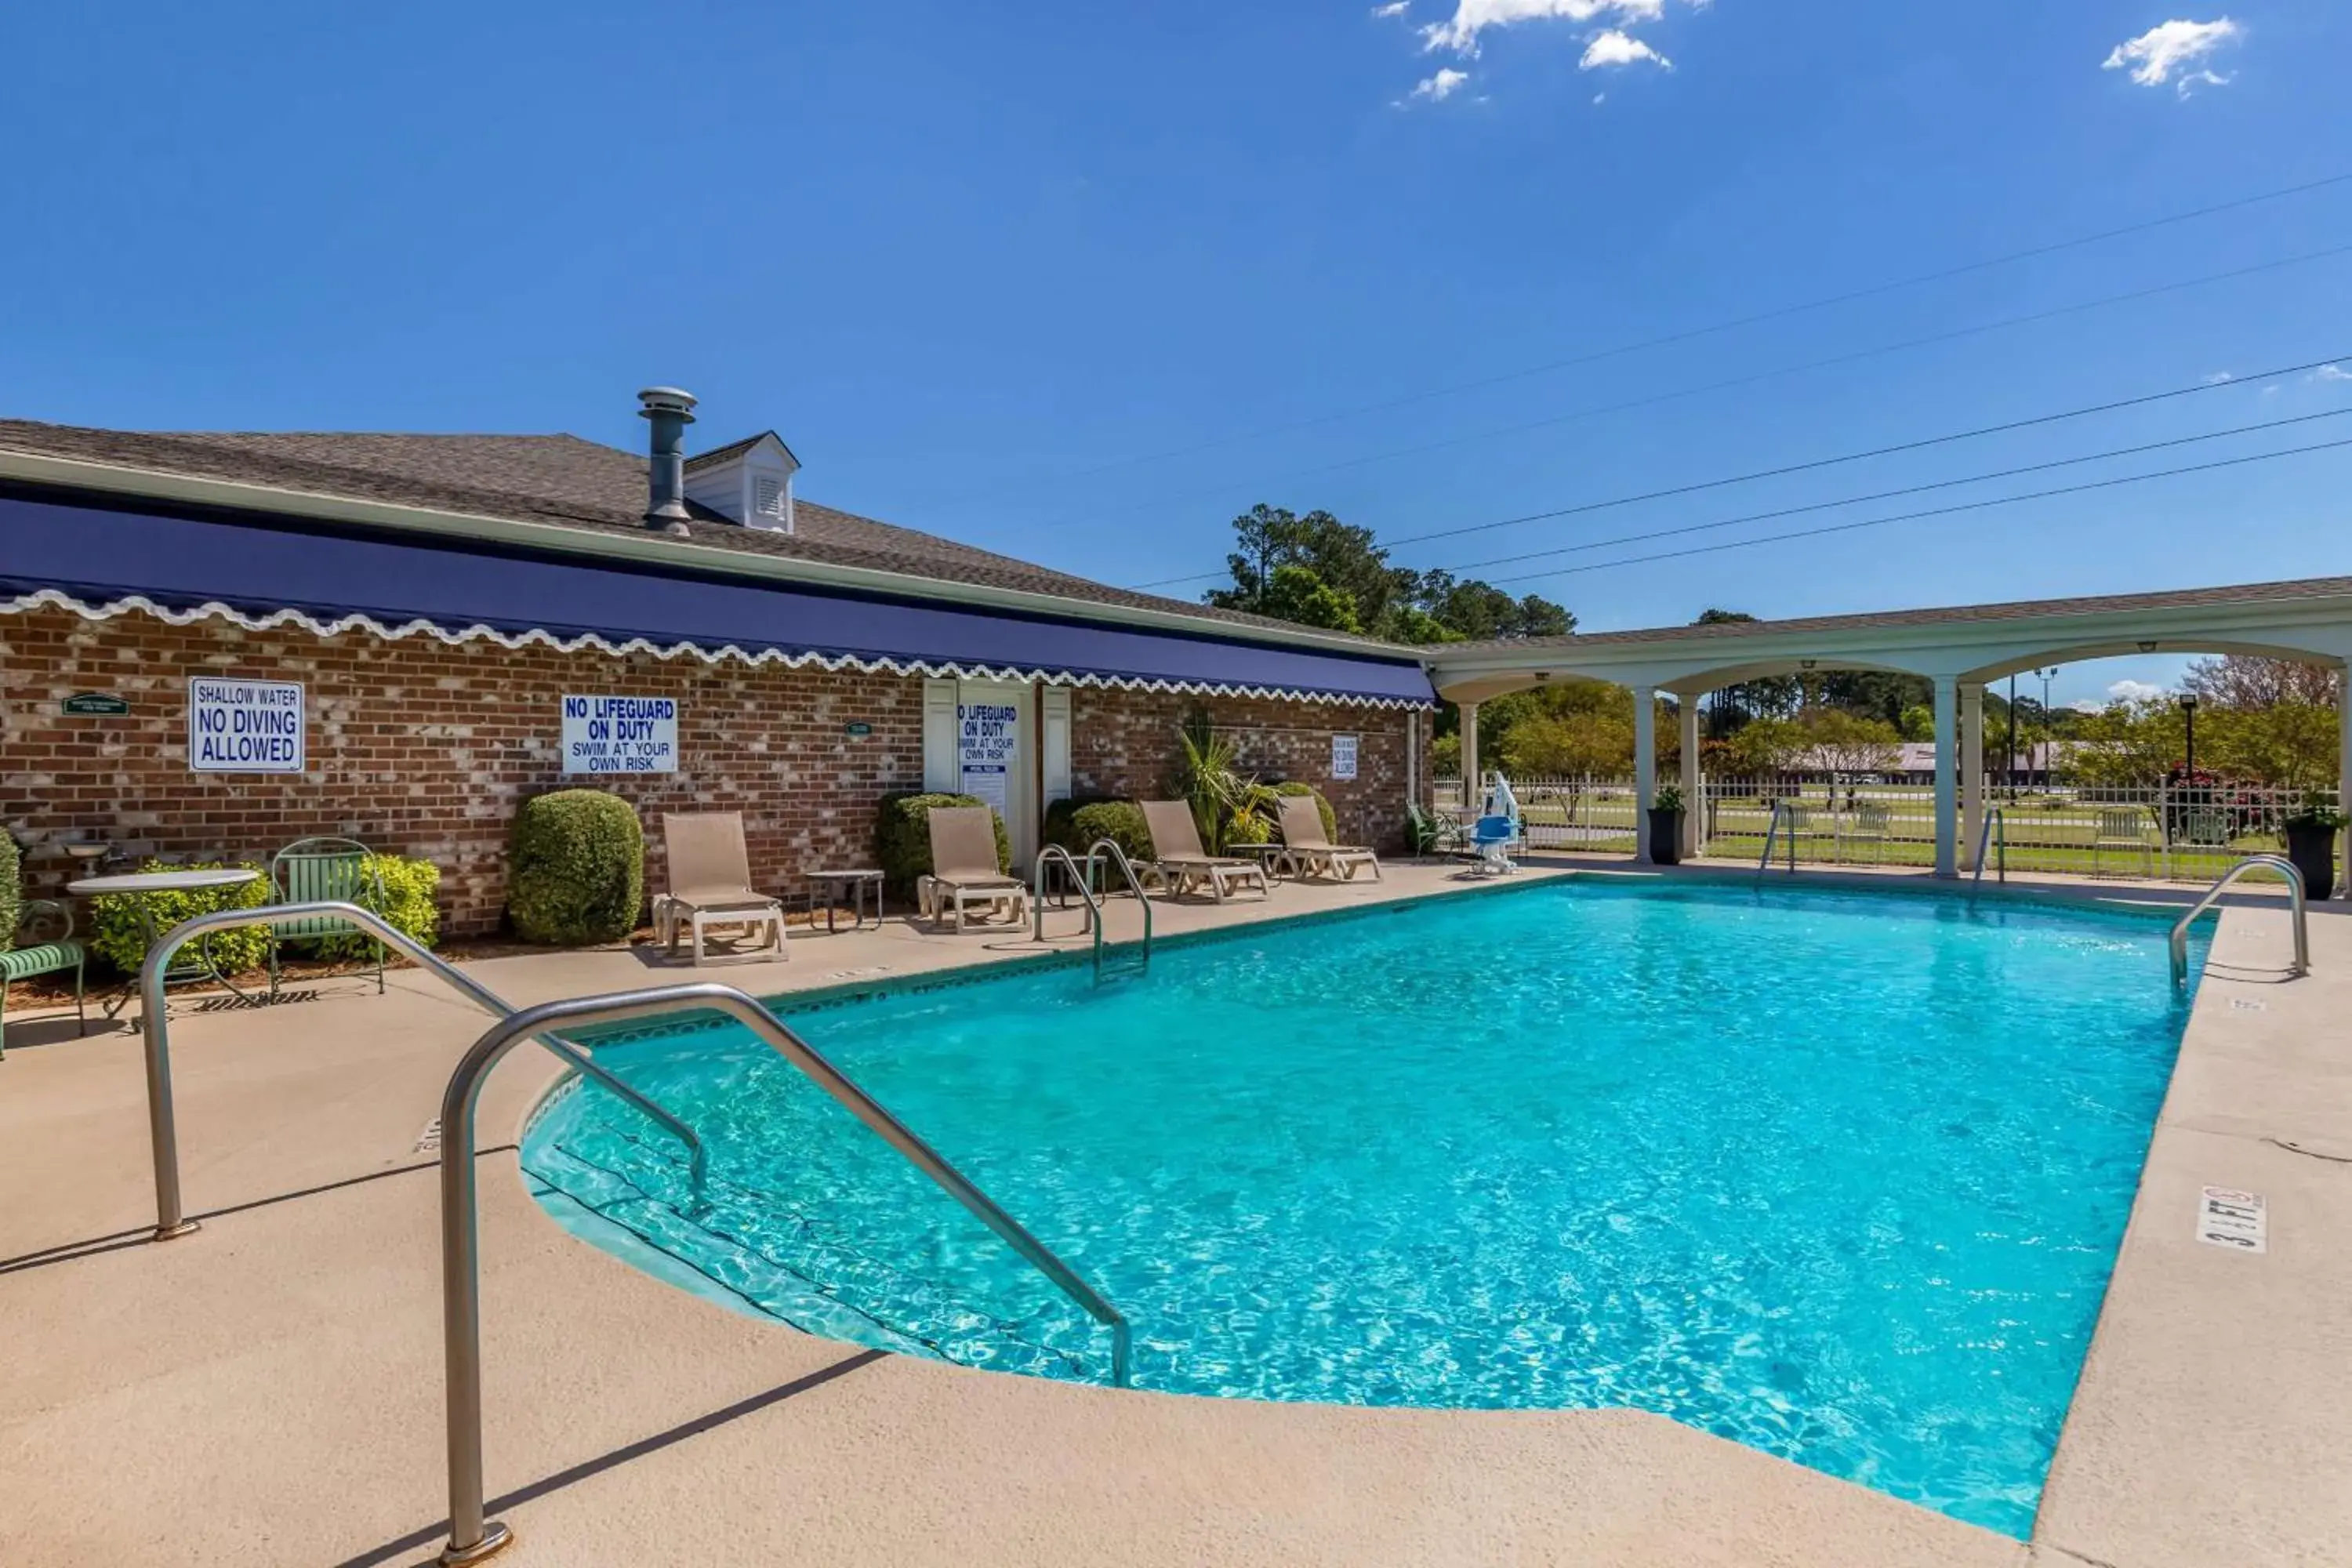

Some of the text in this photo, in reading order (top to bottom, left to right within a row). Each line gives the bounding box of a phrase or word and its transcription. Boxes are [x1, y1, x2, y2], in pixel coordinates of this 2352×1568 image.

[198, 686, 297, 706] SHALLOW WATER
[566, 698, 674, 720] NO LIFEGUARD
[969, 705, 1017, 722] LIFEGUARD
[199, 708, 296, 735] NO DIVING
[589, 720, 655, 740] ON DUTY
[965, 721, 1005, 737] ON DUTY
[201, 736, 294, 762] ALLOWED
[572, 742, 670, 757] SWIM AT YOUR
[980, 738, 989, 749] AT
[993, 738, 1014, 750] YOUR
[965, 749, 1004, 760] OWN RISK
[589, 757, 655, 771] OWN RISK
